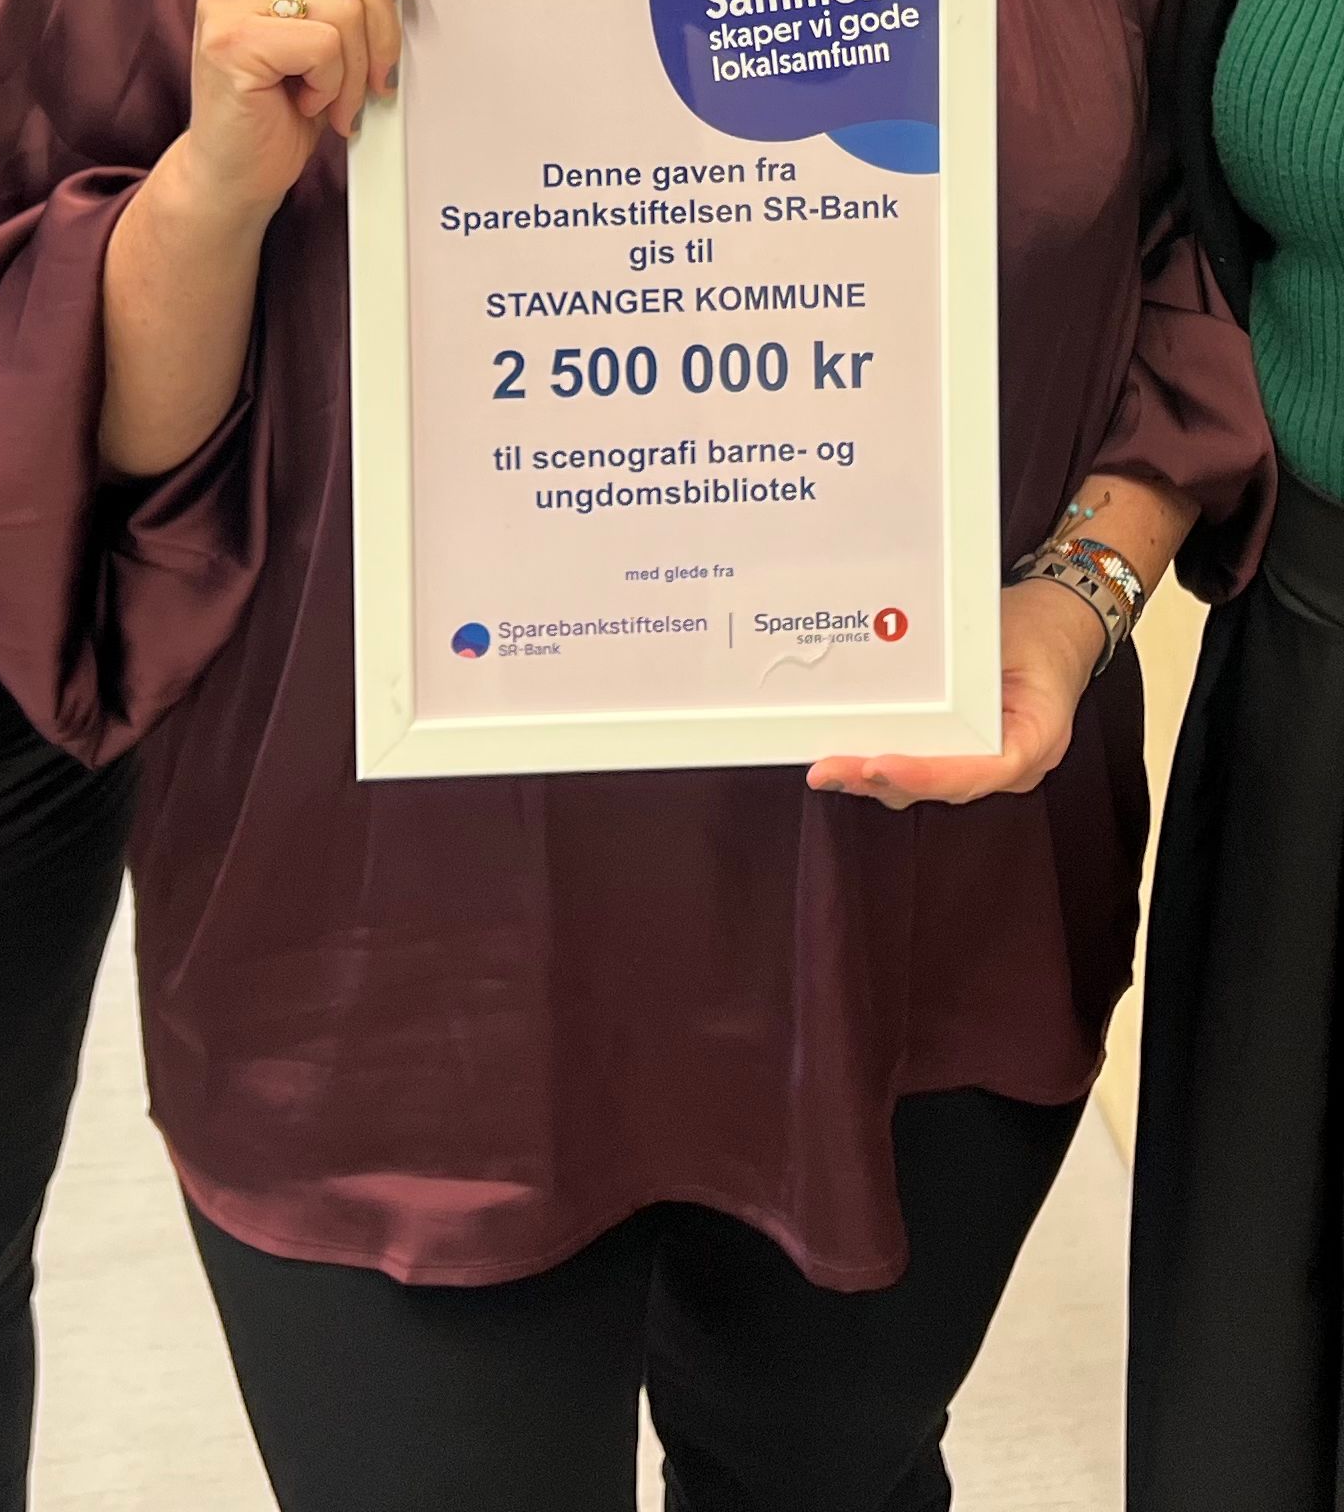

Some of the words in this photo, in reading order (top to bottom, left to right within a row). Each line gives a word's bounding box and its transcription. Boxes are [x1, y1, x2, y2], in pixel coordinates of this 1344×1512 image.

[709, 20, 803, 52] skaper
[809, 9, 832, 39] vi
[839, 2, 920, 41] gode
[712, 41, 891, 82] lokalsamfunn
[542, 163, 641, 188] Denne
[652, 162, 746, 191] gaven
[756, 157, 797, 182] fra
[440, 199, 753, 236] Sparebankstiftelsen
[763, 194, 900, 222] SR-Bank
[629, 240, 675, 271] gis
[685, 238, 714, 264] til
[486, 288, 685, 319] STAVANGER
[695, 282, 867, 312] KOMMUNE
[492, 349, 526, 400] 2
[550, 345, 657, 398] 500
[681, 341, 789, 394] 000
[813, 340, 874, 390] kr
[492, 445, 521, 471] til
[532, 440, 697, 473] scenografi
[708, 439, 807, 464] barne-
[816, 441, 855, 467] og
[536, 476, 816, 515] ungdomsbibliotek
[625, 567, 659, 581] med
[664, 565, 708, 583] glede
[712, 564, 734, 579] fra
[498, 616, 708, 643] Sparebankstiftelsen
[754, 611, 869, 635] SpareBank
[498, 641, 561, 657] SR-Bank
